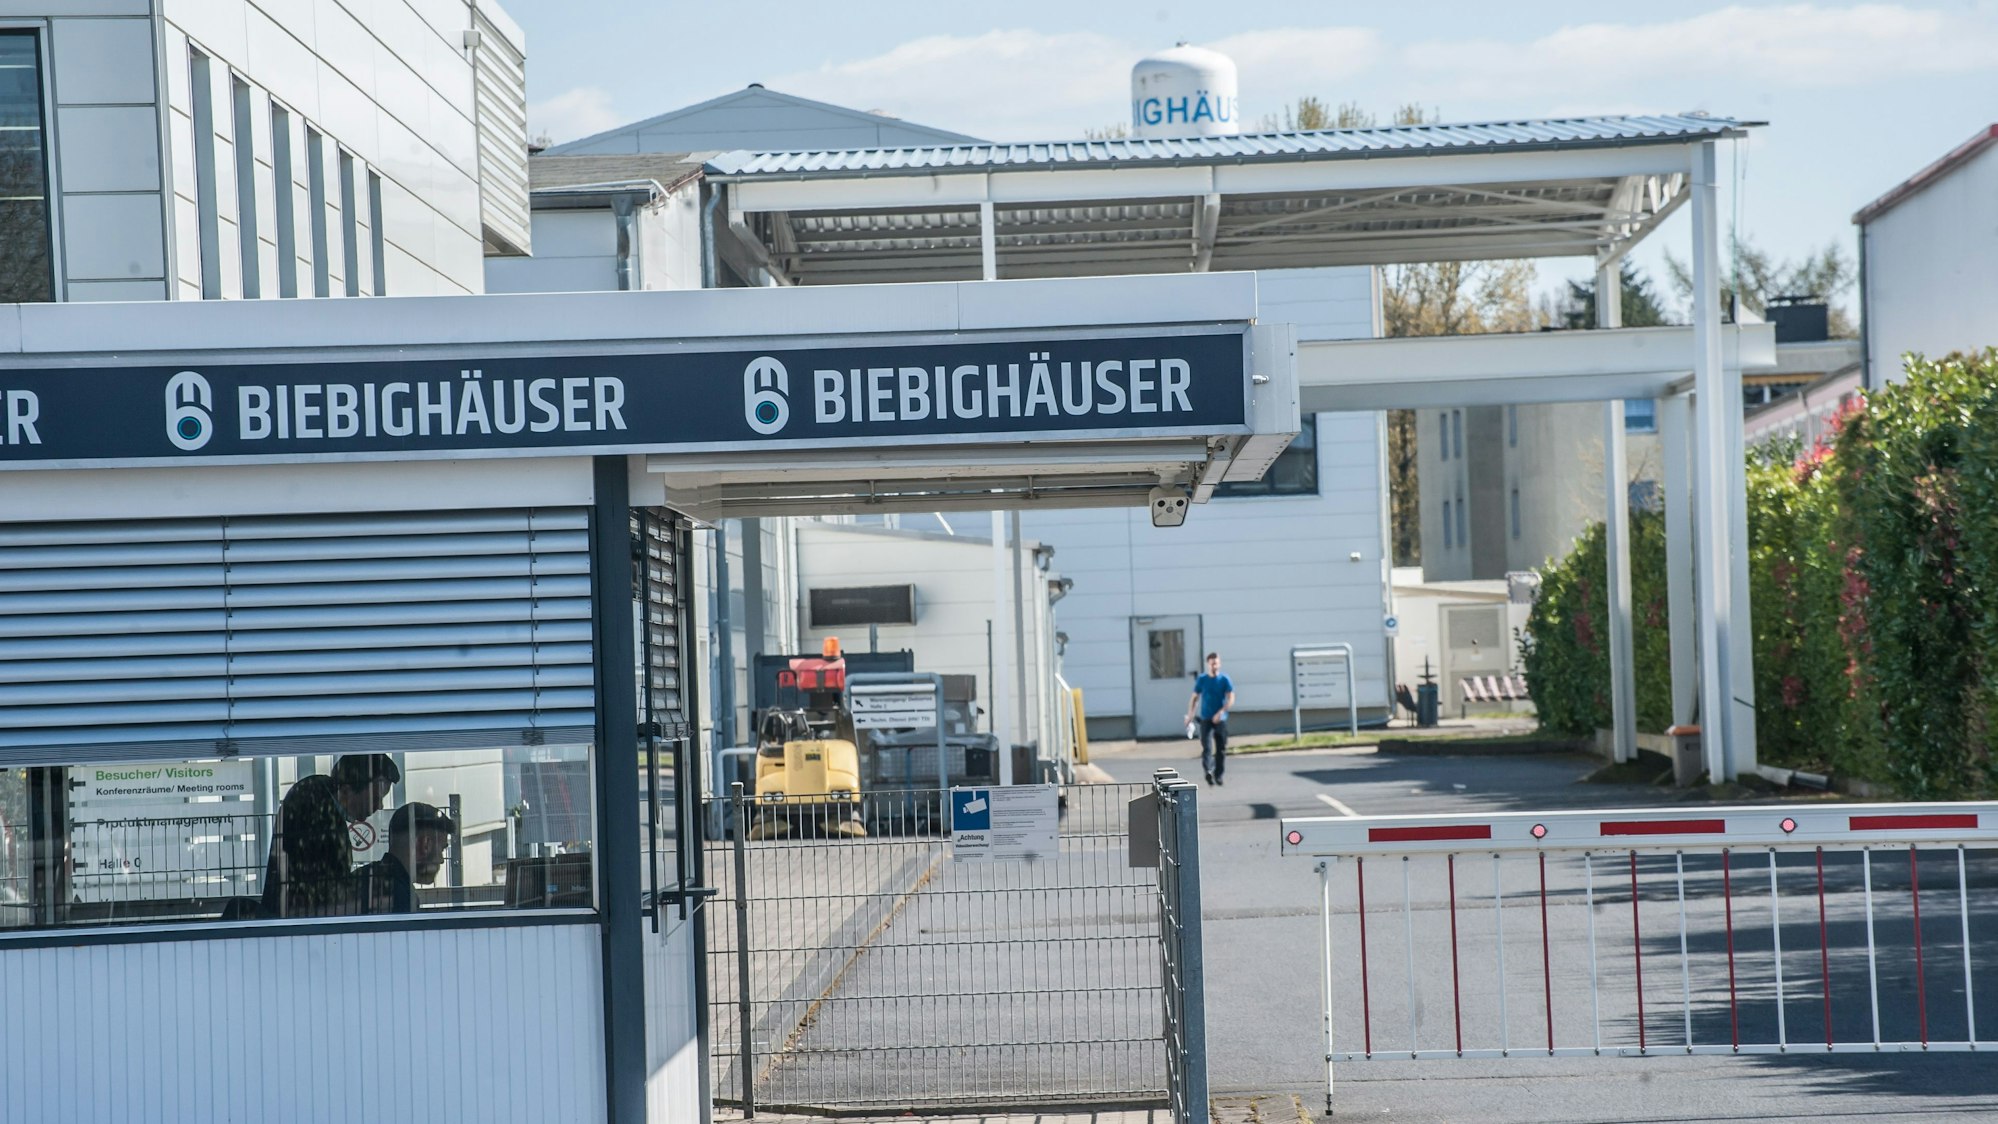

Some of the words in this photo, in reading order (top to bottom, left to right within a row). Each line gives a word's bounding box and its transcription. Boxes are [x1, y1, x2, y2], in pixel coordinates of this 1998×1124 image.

[237, 370, 628, 440] BIEBIGHÄUSER
[814, 351, 1194, 424] BIEBIGHÄUSER
[0, 389, 42, 445] R
[95, 768, 162, 781] Besucher/
[165, 767, 214, 778] Visitors
[96, 785, 175, 796] Konferenzräume/
[177, 783, 214, 794] Meeting
[216, 782, 245, 791] rooms
[100, 857, 131, 870] Halle
